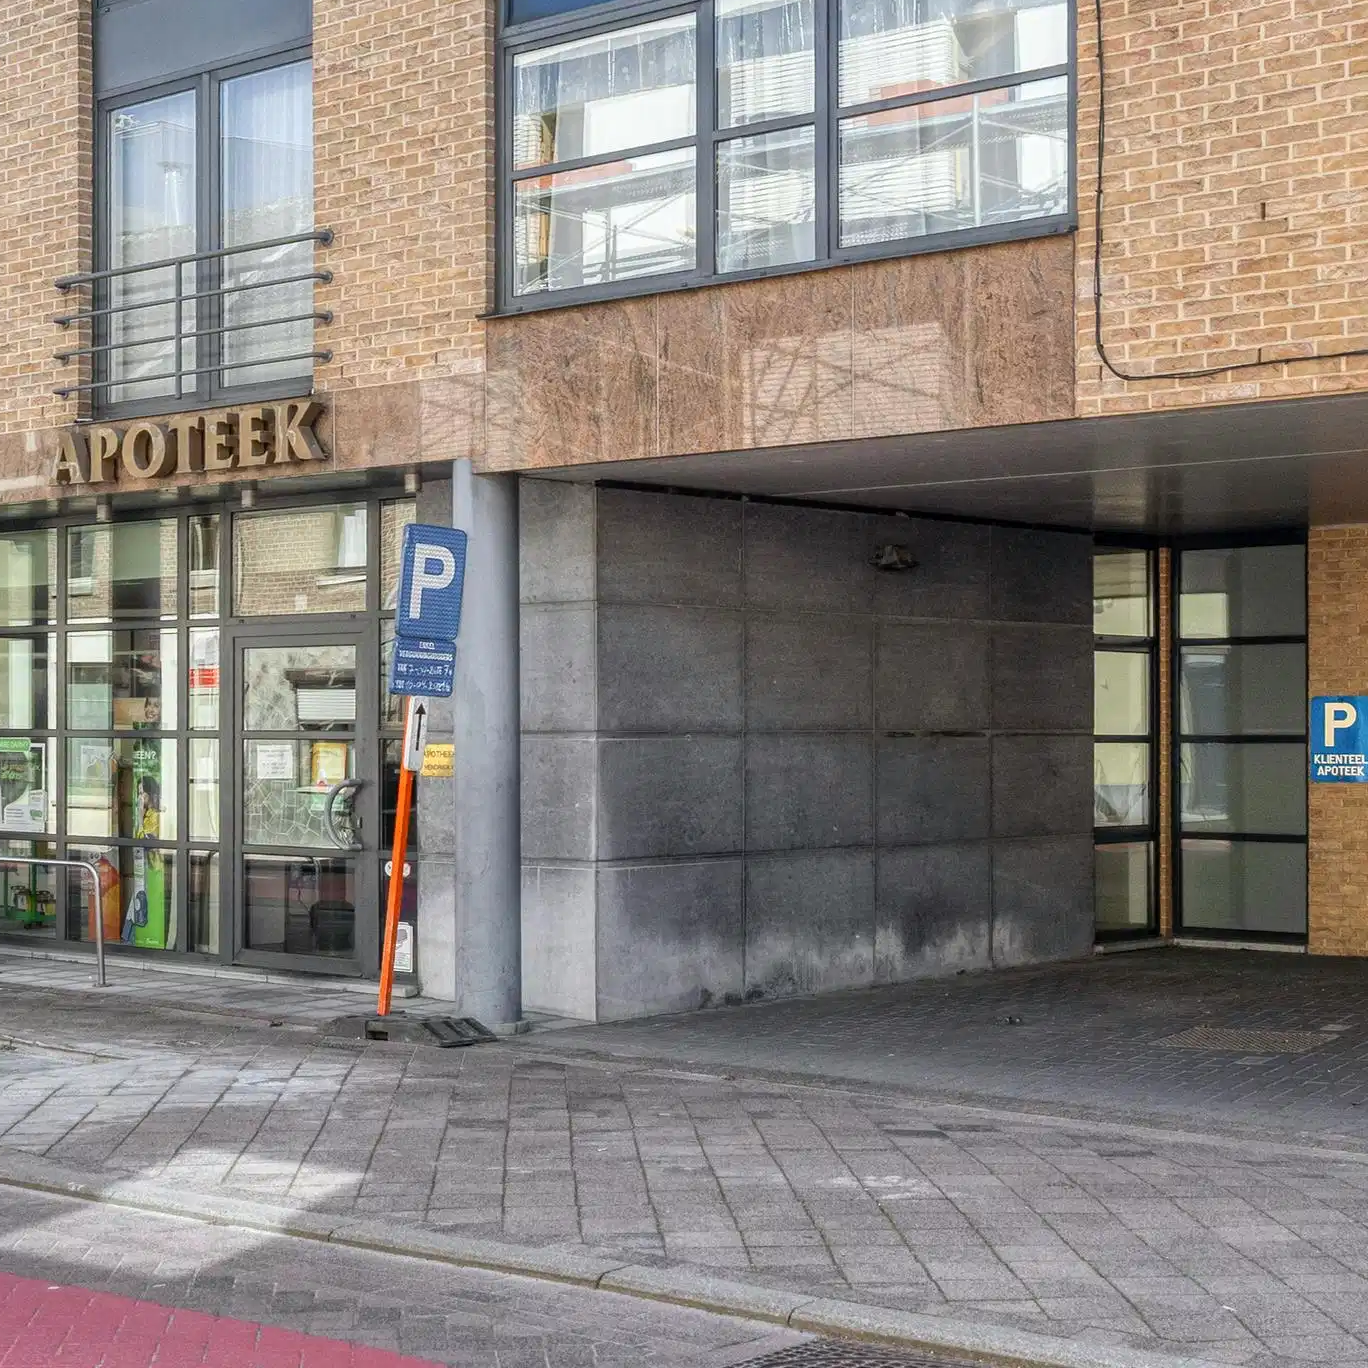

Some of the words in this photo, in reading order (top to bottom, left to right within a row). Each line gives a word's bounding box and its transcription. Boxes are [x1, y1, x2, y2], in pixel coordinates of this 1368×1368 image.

[49, 400, 329, 485] APOTEEK
[409, 543, 455, 619] P
[1324, 702, 1357, 747] P
[1314, 754, 1368, 764] KLIENTEEL
[1317, 766, 1365, 776] APOTEEK
